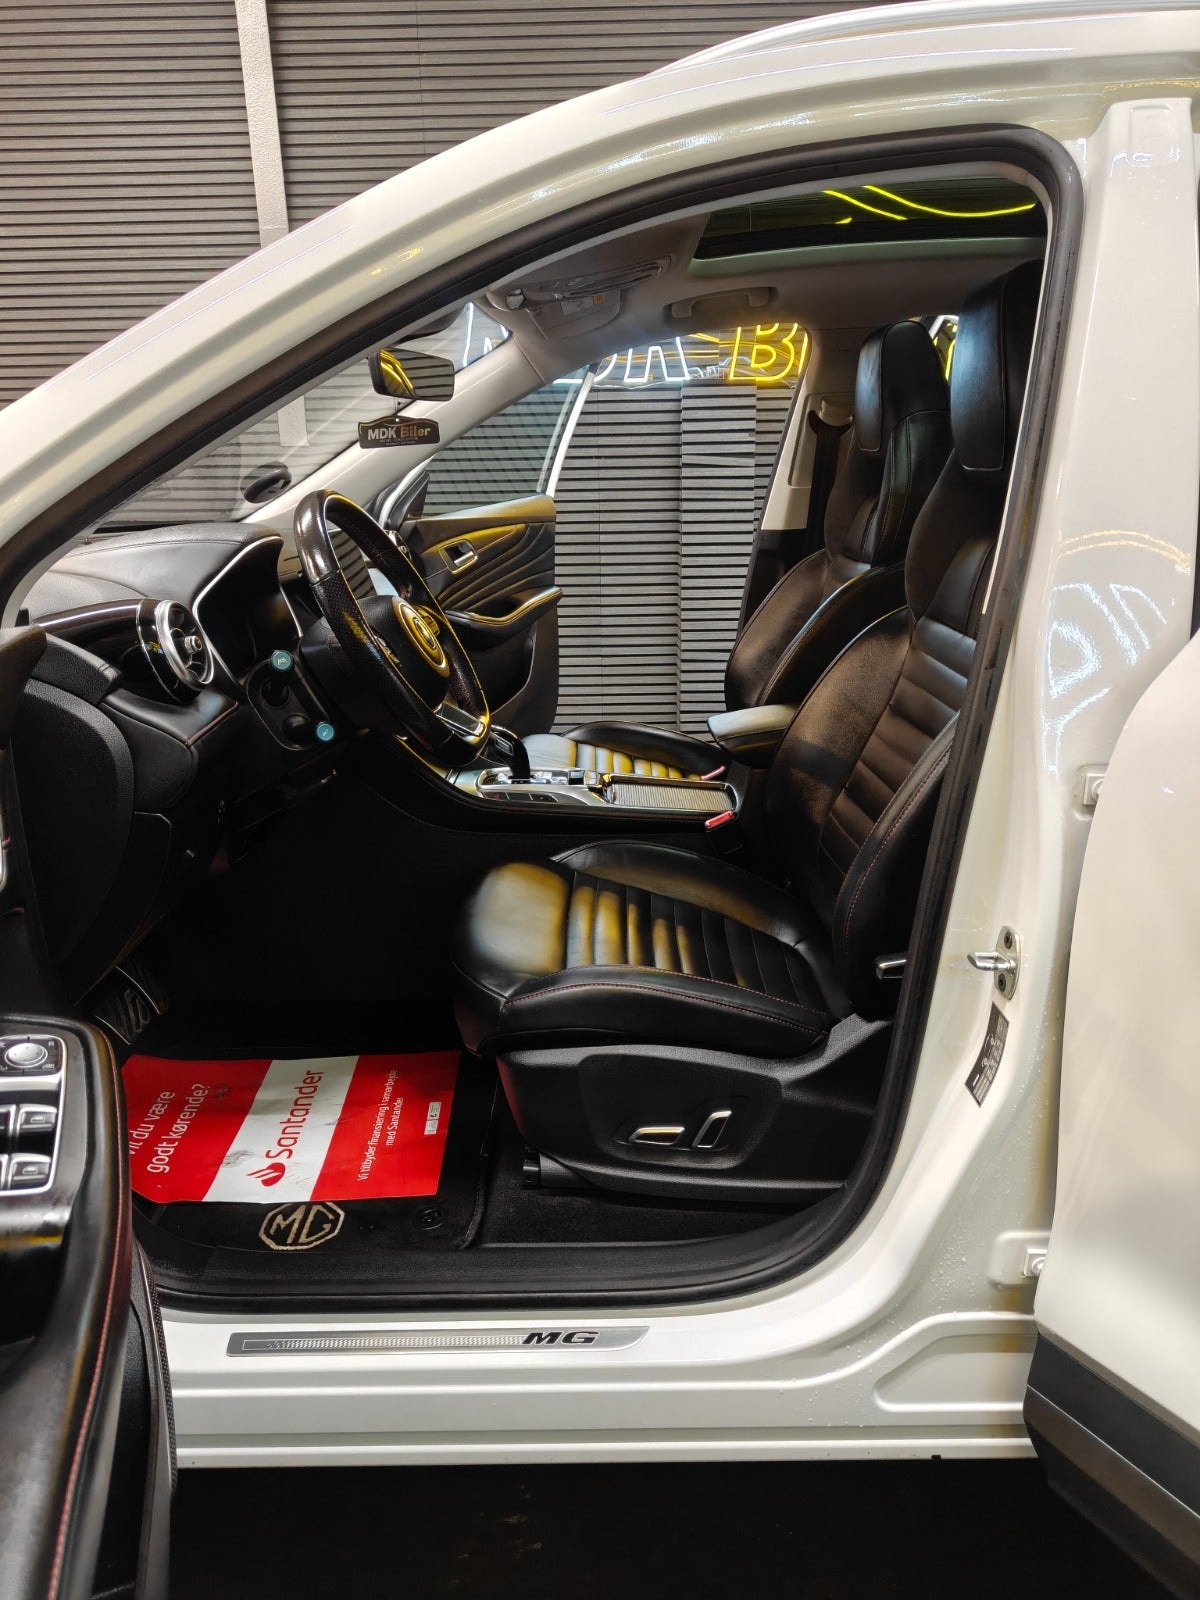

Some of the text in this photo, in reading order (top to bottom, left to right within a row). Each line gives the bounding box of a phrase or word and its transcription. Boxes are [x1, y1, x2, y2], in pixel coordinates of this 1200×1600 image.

[367, 424, 431, 440] MDK Biler
[129, 1123, 155, 1139] du
[144, 1091, 176, 1121] være
[146, 1083, 211, 1174] godt kørende?
[265, 1070, 324, 1159] Santander
[367, 1106, 389, 1145] finansiering
[385, 1097, 404, 1146] med Santander
[357, 1173, 370, 1182] Vi
[360, 1145, 377, 1173] tilbyder
[269, 1204, 335, 1244] MG
[522, 1331, 599, 1345] MG
